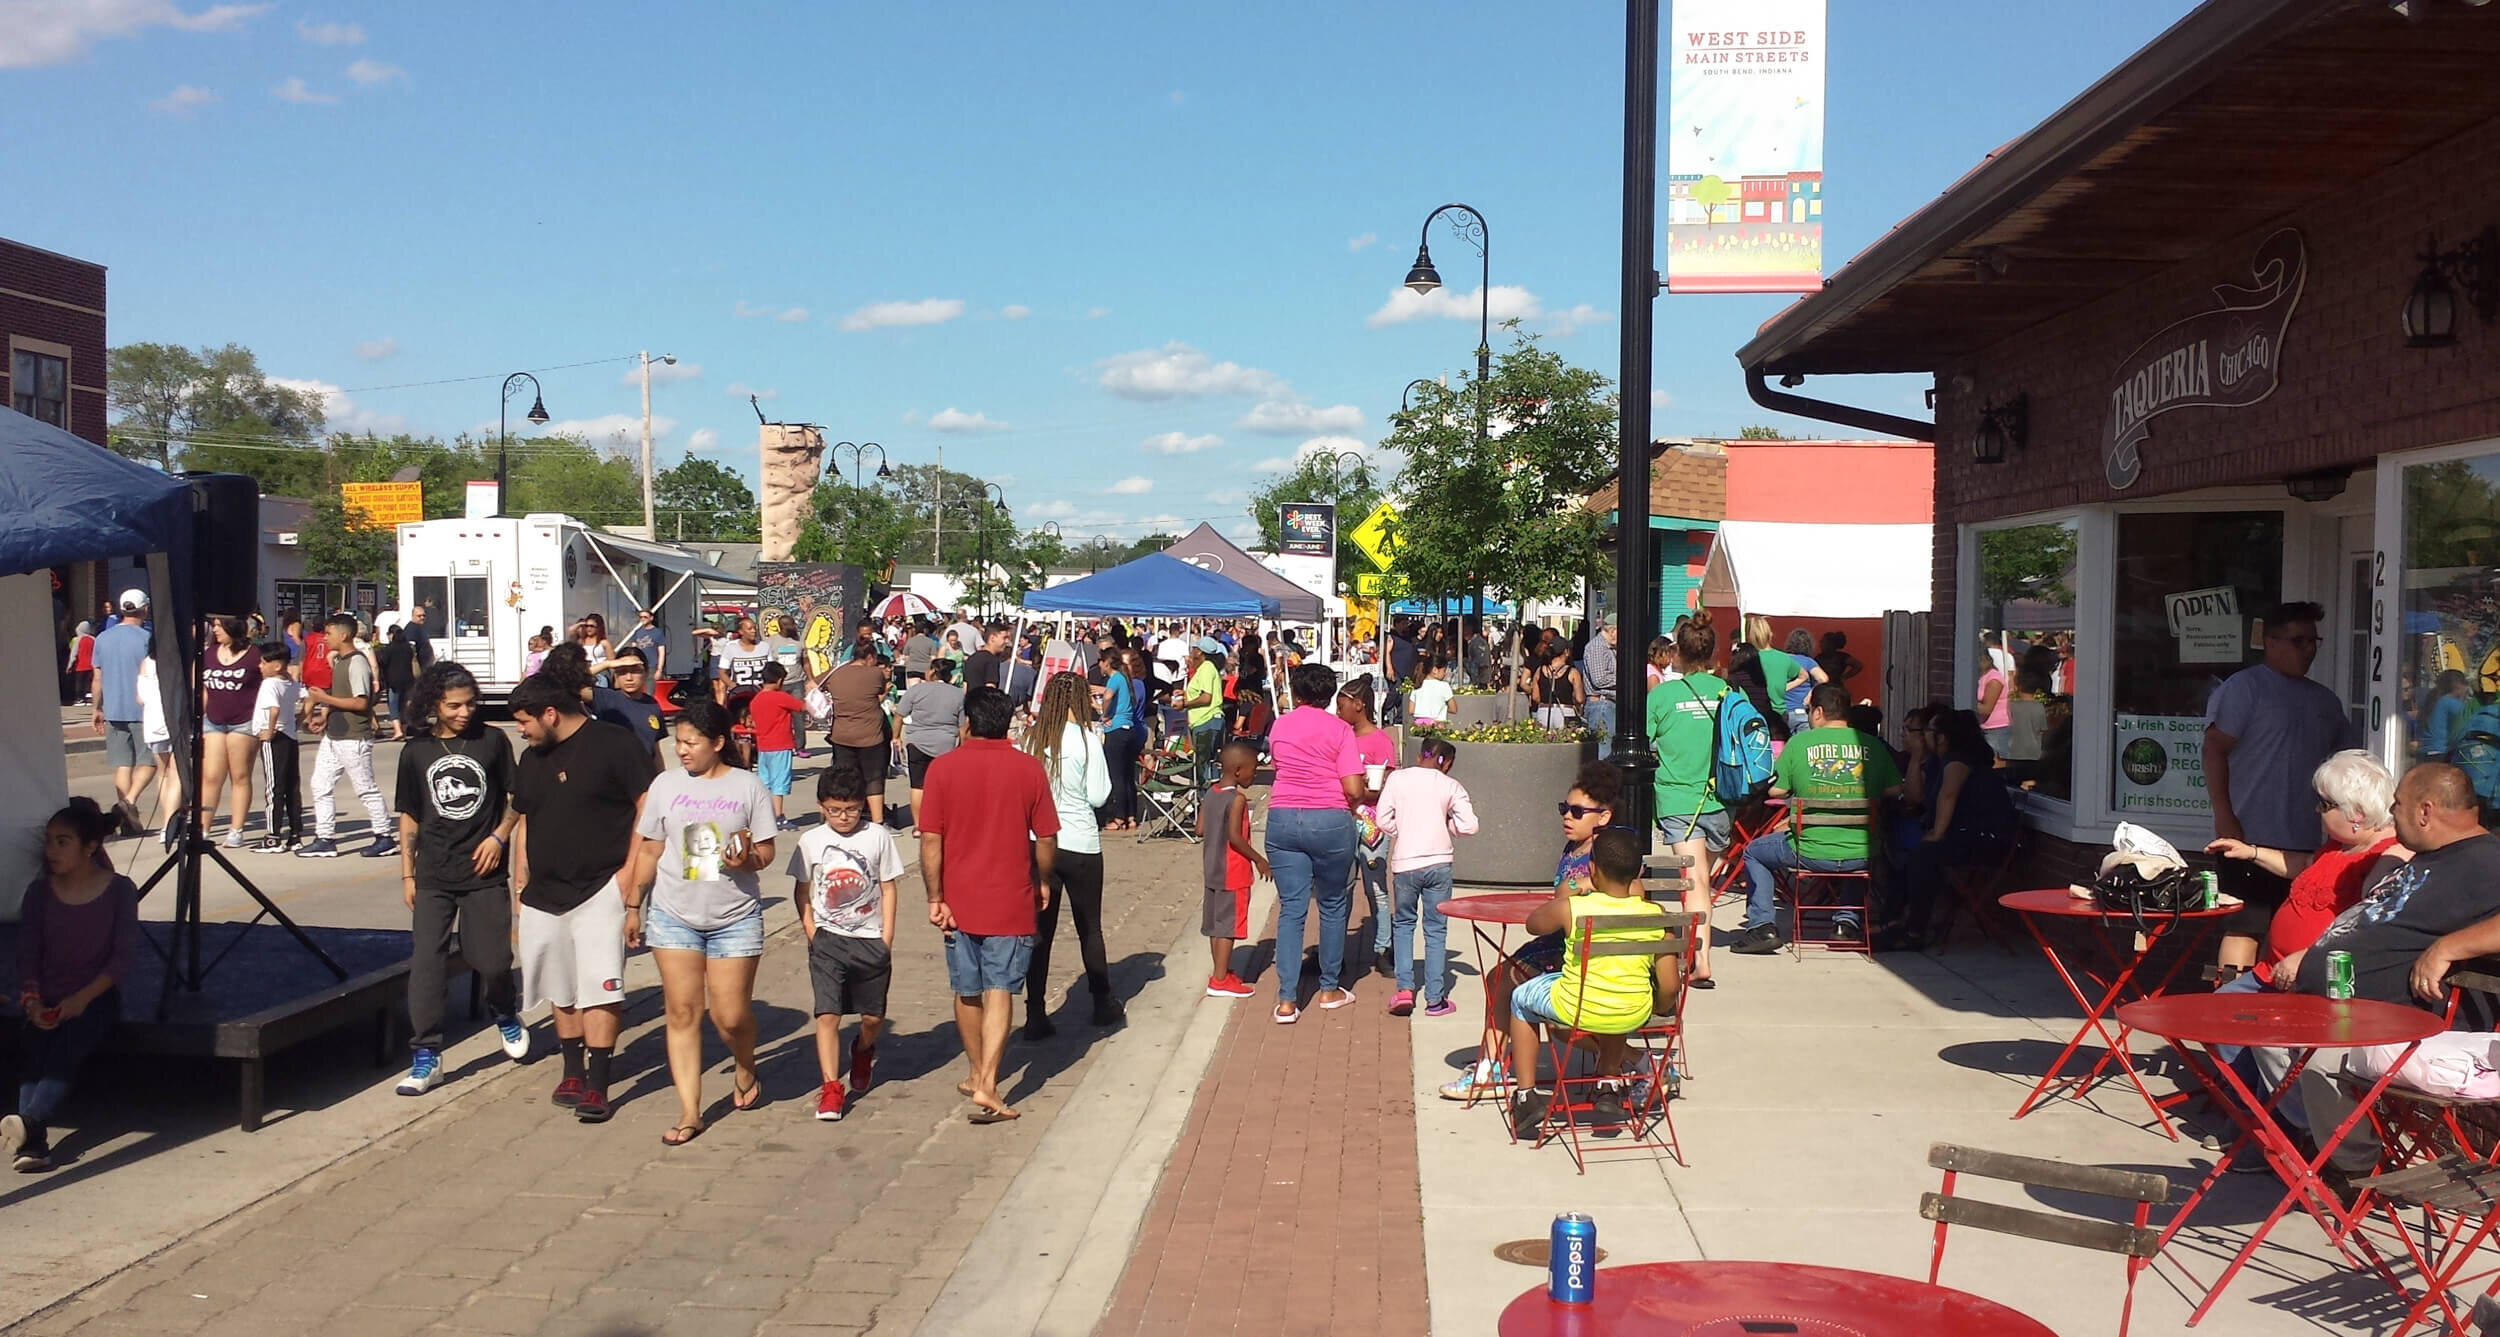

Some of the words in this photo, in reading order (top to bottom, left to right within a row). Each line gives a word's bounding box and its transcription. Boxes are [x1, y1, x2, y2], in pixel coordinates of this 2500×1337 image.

[1688, 32, 1749, 47] WEST
[1757, 31, 1806, 45] SIDE
[1686, 53, 1729, 64] MAIN
[1735, 52, 1809, 63] STREETS
[2112, 339, 2211, 441] TAQUERIA
[2218, 334, 2269, 386] CHICAGO
[2173, 592, 2232, 629] OPEN
[2371, 551, 2385, 731] 2920
[202, 668, 246, 680] good
[2120, 719, 2132, 730] Jr
[2137, 718, 2165, 731] Irish
[1806, 743, 1839, 762] NOTRE
[1841, 744, 1870, 761] DAME
[2174, 742, 2201, 754] TRY
[2171, 758, 2201, 771] REG
[669, 793, 739, 815] Preston
[1567, 1235, 1583, 1289] pepsi
